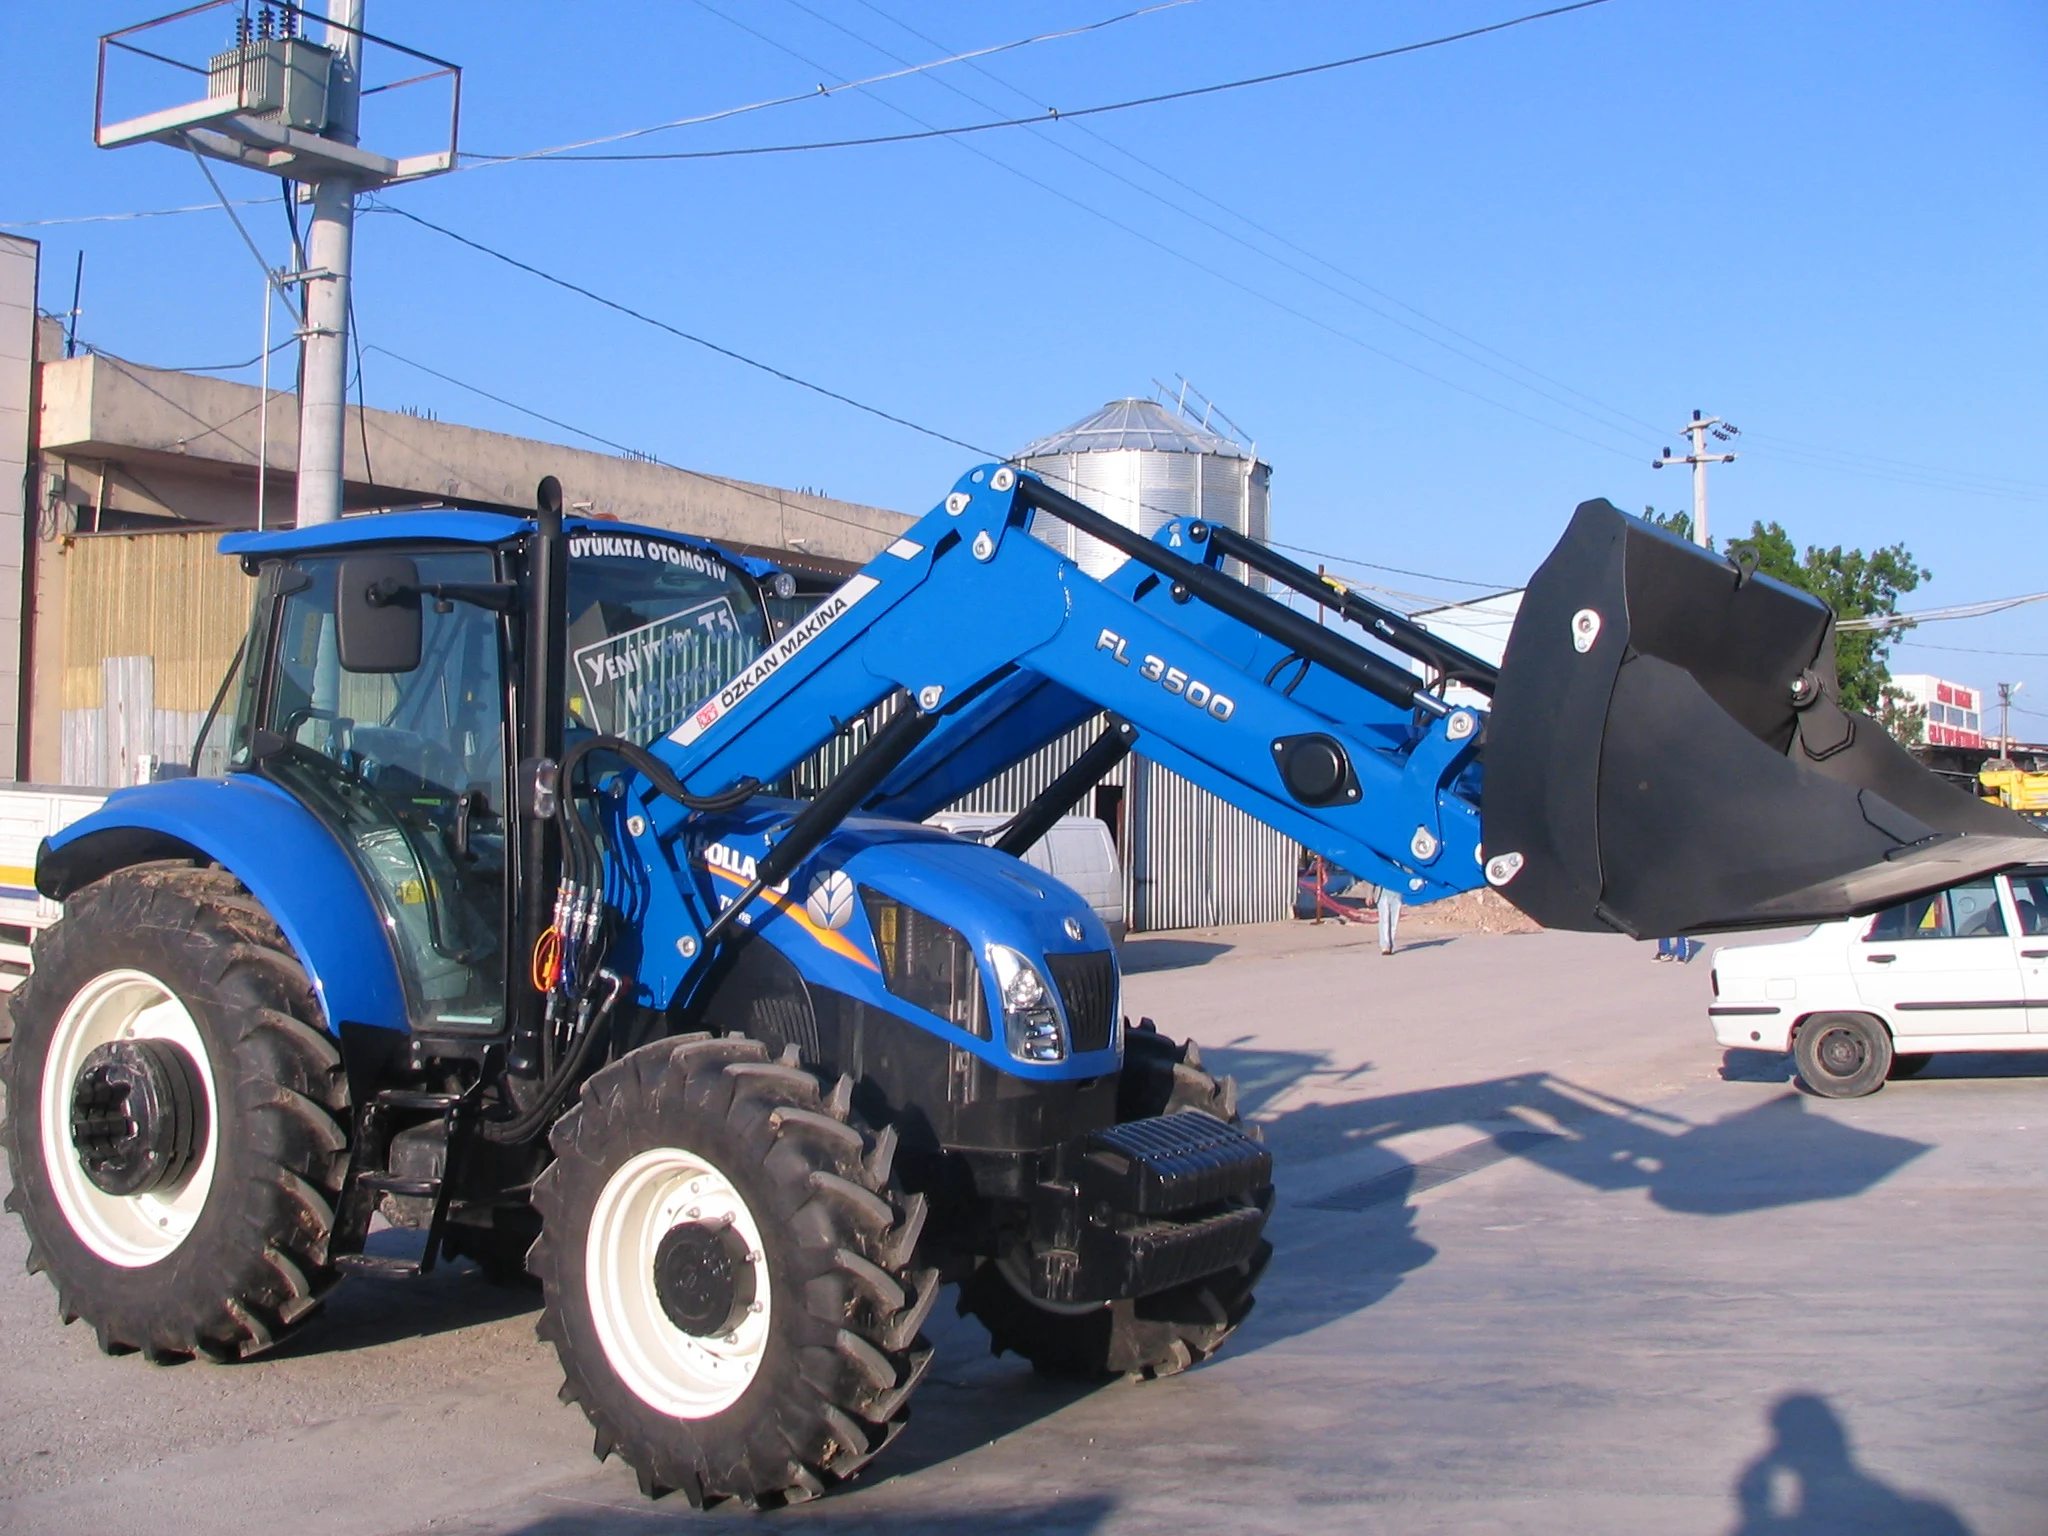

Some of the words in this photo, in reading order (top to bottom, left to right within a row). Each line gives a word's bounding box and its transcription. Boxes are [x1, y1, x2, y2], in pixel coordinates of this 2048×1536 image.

[569, 533, 645, 558] ÜYÜKATA
[647, 542, 728, 582] OTOMOTİV
[585, 644, 641, 687] YENİ
[698, 608, 734, 644] T5
[721, 655, 779, 708] ÖZKAN
[780, 598, 847, 659] MAKİNA
[1095, 628, 1131, 667] FL
[1139, 653, 1236, 723] 3500
